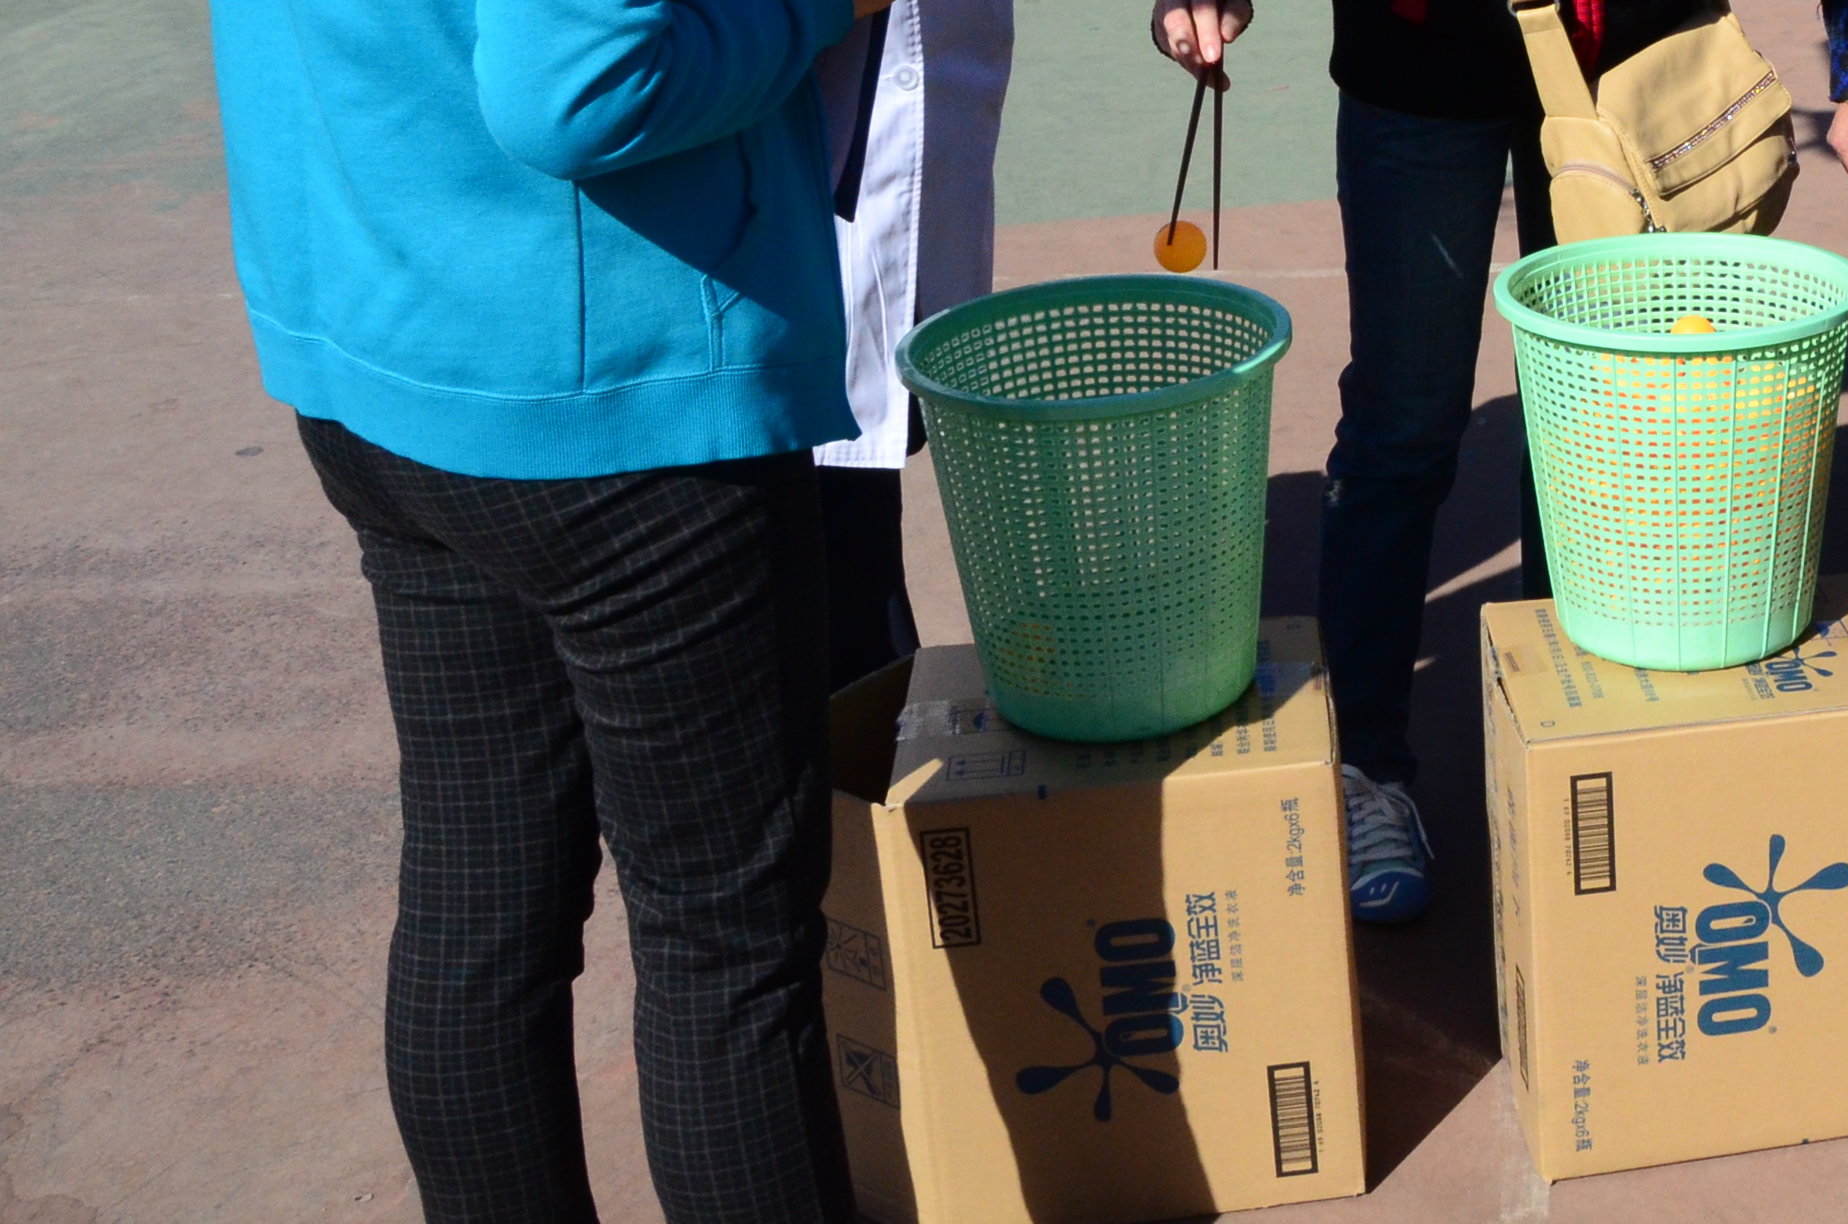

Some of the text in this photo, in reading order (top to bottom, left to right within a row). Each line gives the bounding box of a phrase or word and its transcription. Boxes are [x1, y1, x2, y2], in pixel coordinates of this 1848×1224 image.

[1764, 660, 1813, 693] OMO
[929, 835, 972, 941] 20273628
[1095, 918, 1184, 1055] OMO
[1185, 891, 1229, 1053] 奥妙 净蓝全效
[1654, 905, 1688, 1064] 奥妙 净蓝全效
[1695, 900, 1772, 1036] OMO
